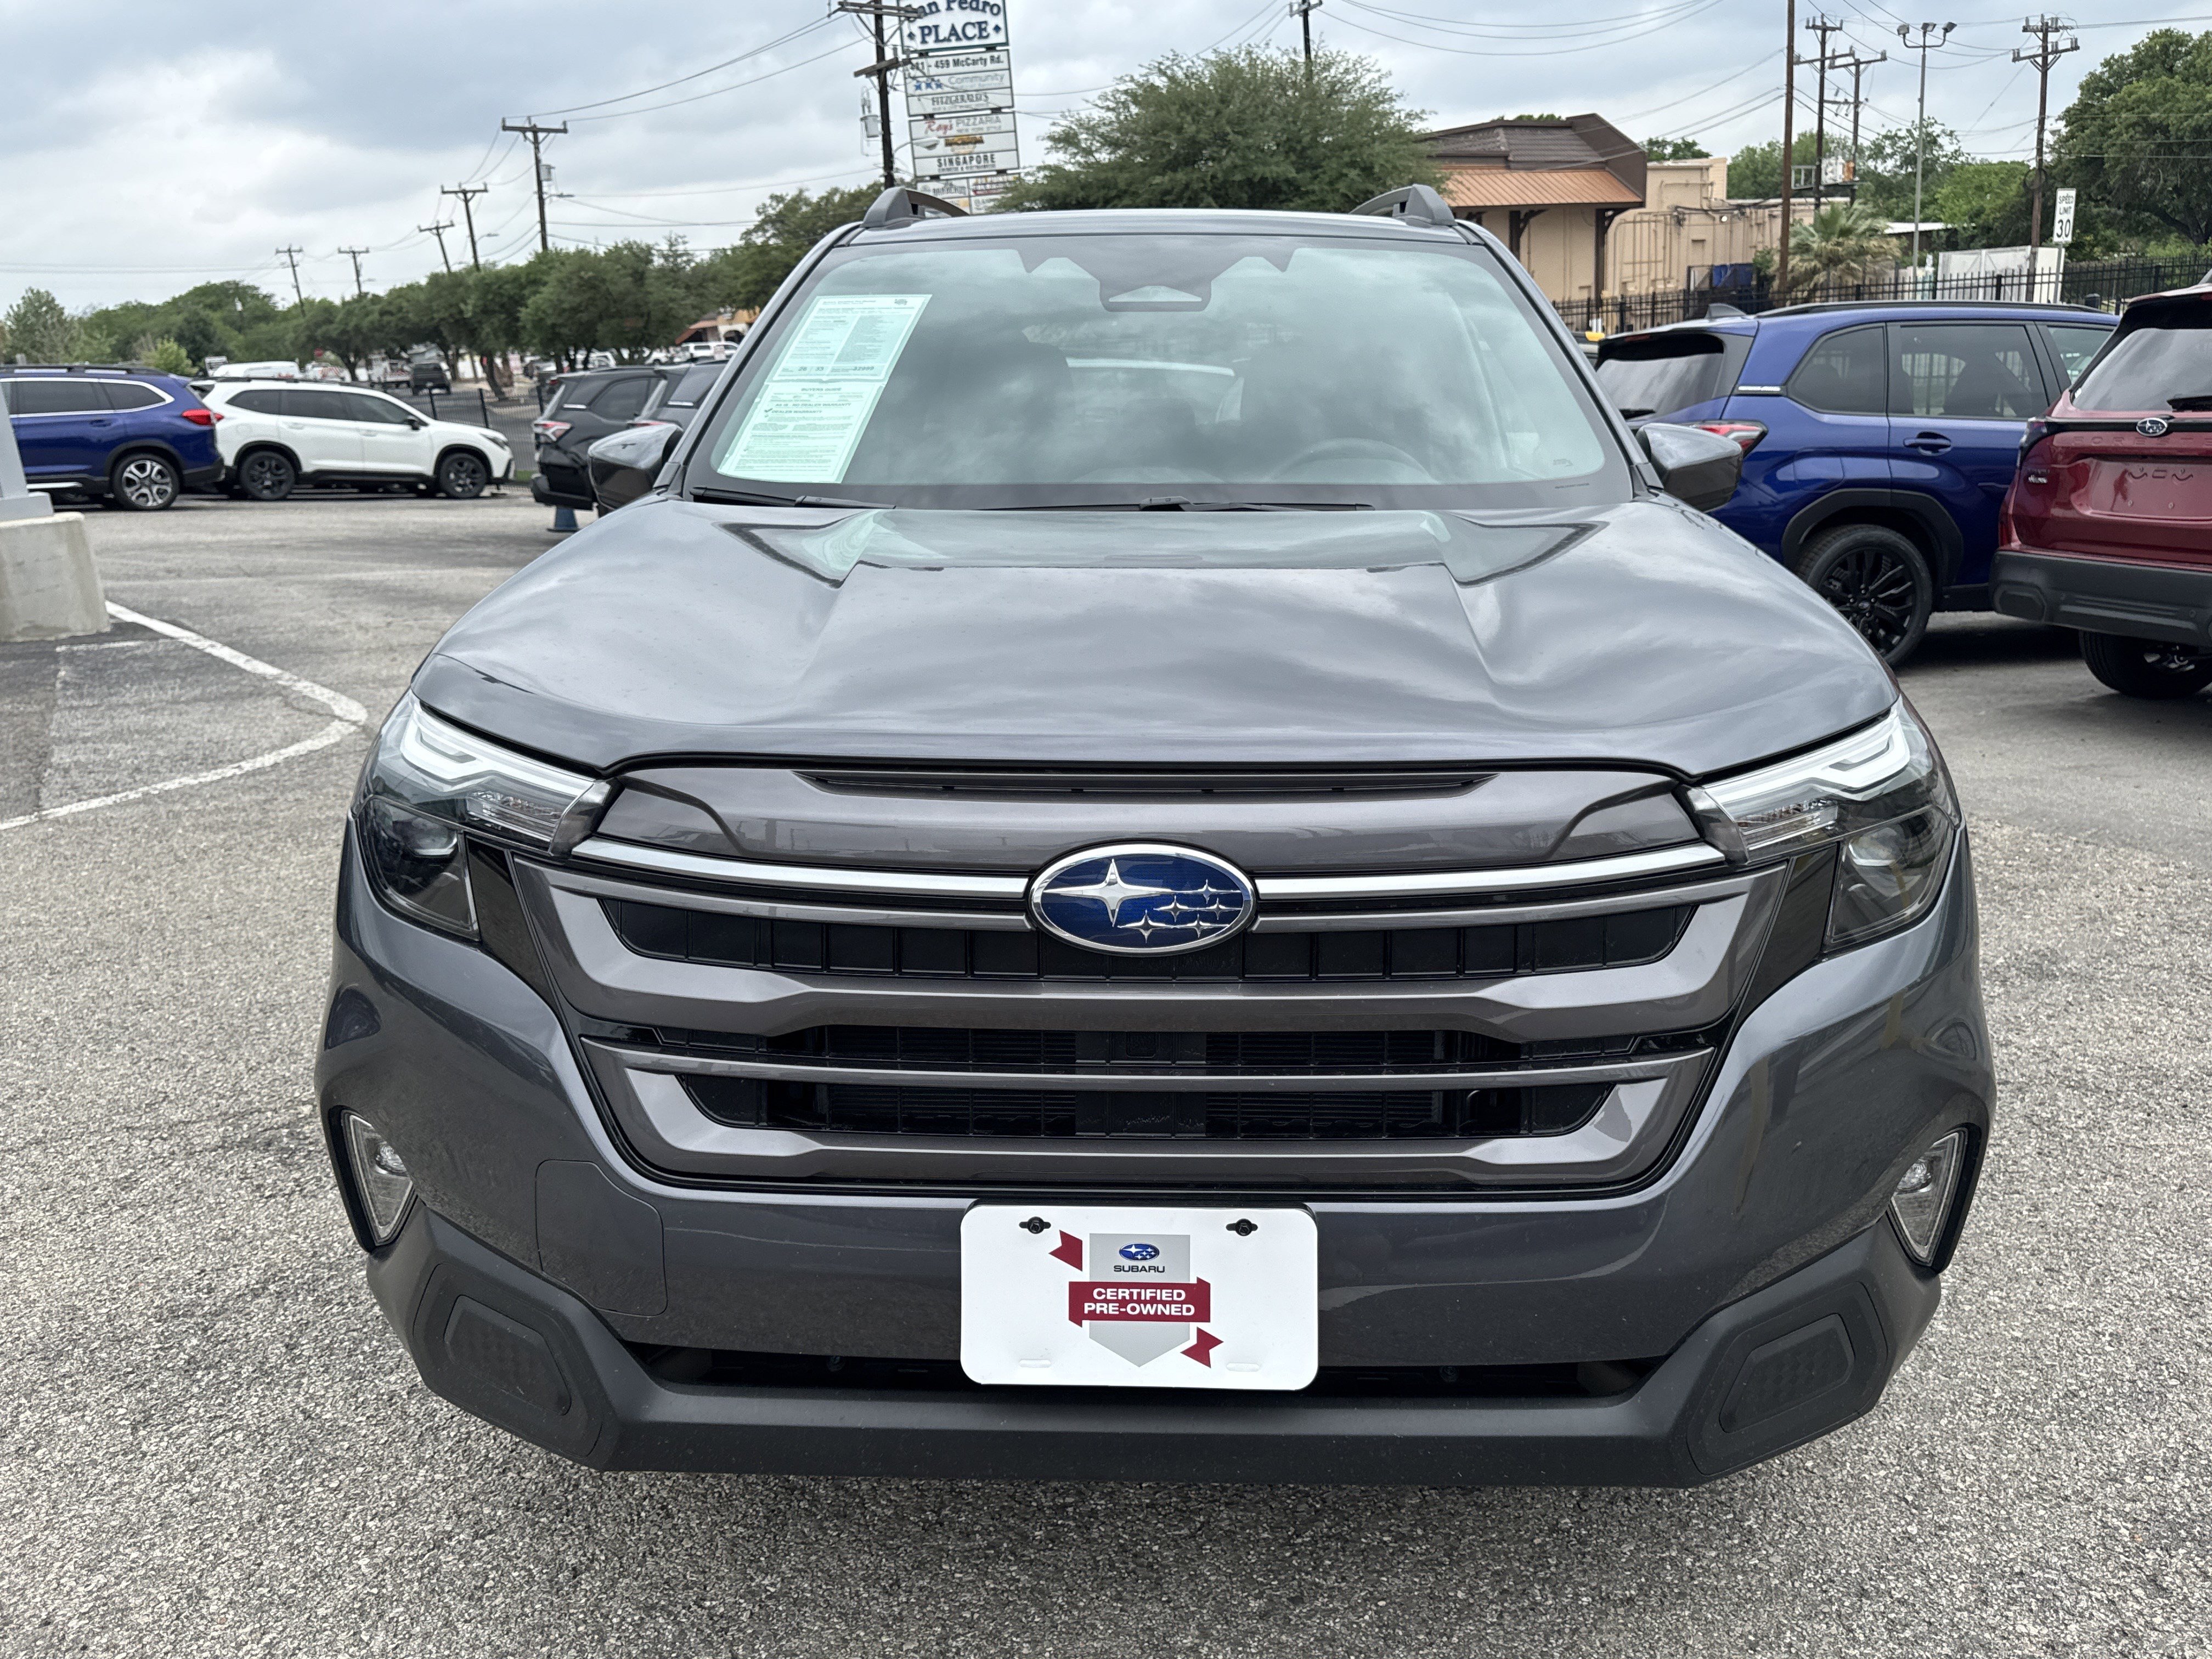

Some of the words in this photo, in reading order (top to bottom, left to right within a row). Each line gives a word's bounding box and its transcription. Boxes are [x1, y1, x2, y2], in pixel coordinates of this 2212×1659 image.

[946, 0, 1001, 15] Pedro
[918, 21, 990, 44] PLACE
[952, 57, 987, 67] McCarty
[990, 54, 1003, 64] Rd.
[948, 74, 1005, 84] Community
[936, 154, 996, 167] SINGAPORE
[2056, 219, 2071, 238] 30
[1093, 1288, 1186, 1301] CERTIFIED
[1084, 1302, 1195, 1316] PRE-OWNED
